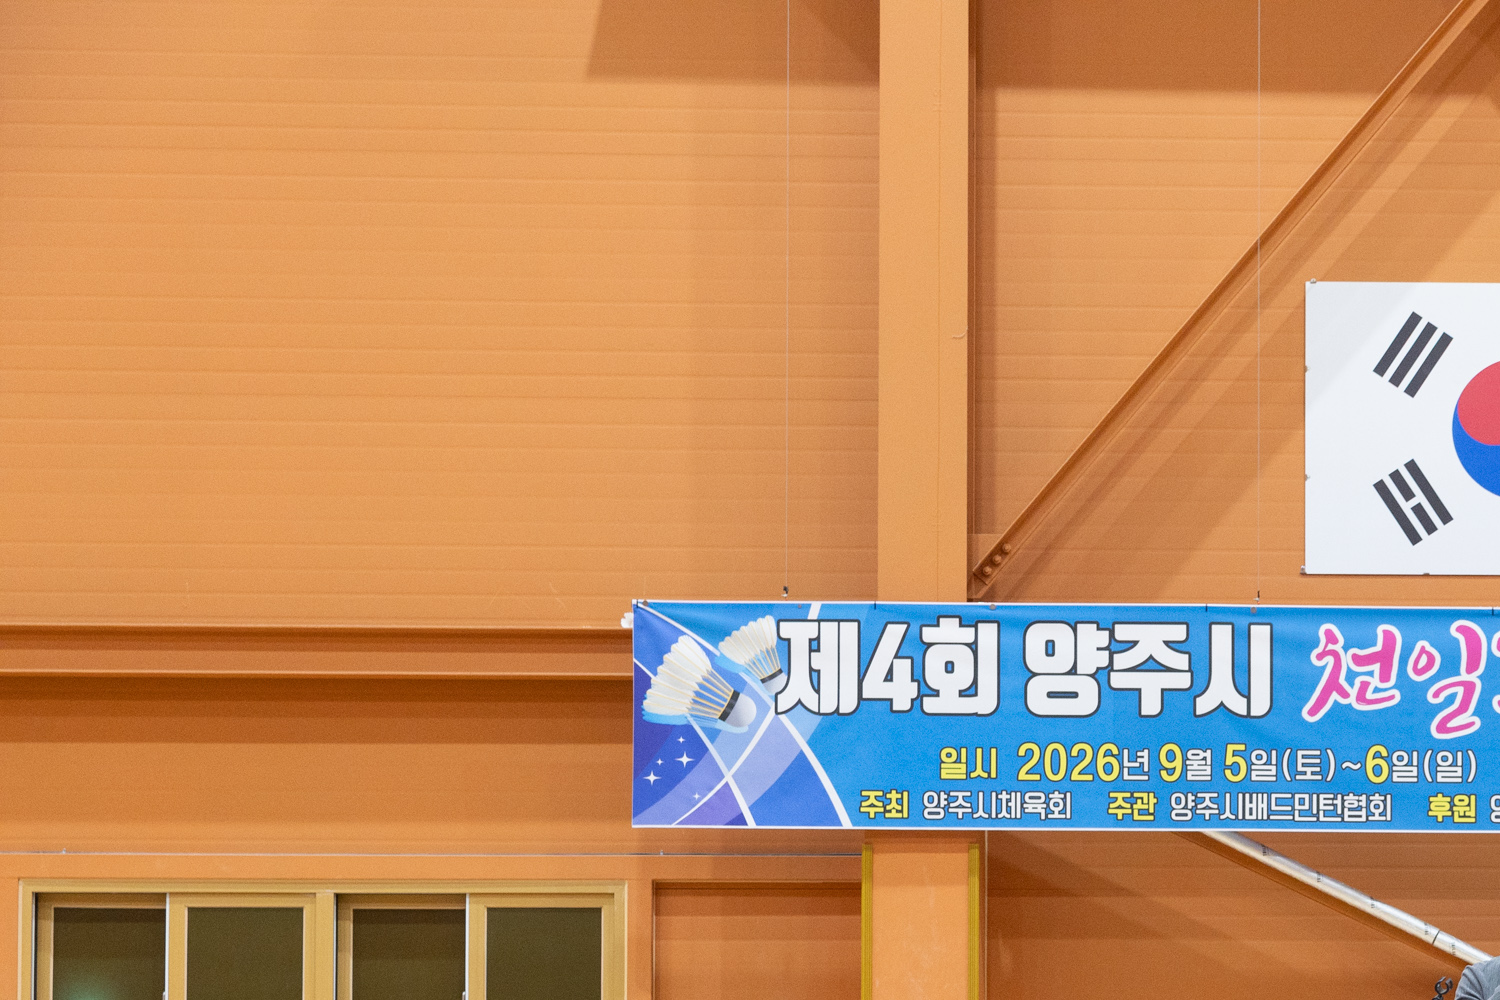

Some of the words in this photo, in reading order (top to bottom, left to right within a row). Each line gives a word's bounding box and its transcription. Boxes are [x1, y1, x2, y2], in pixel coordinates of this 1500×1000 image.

[775, 615, 999, 716] 제4회
[1024, 621, 1273, 718] 양주시
[940, 747, 997, 780] 일시
[1018, 742, 1149, 782] 2026년
[1159, 743, 1212, 782] 9월
[860, 789, 909, 819] 주최
[923, 790, 1071, 820] 양주시체육회
[1108, 792, 1158, 821] 주관
[1170, 792, 1391, 822] 양주시배드민턴협회
[1428, 793, 1476, 823] 후원
